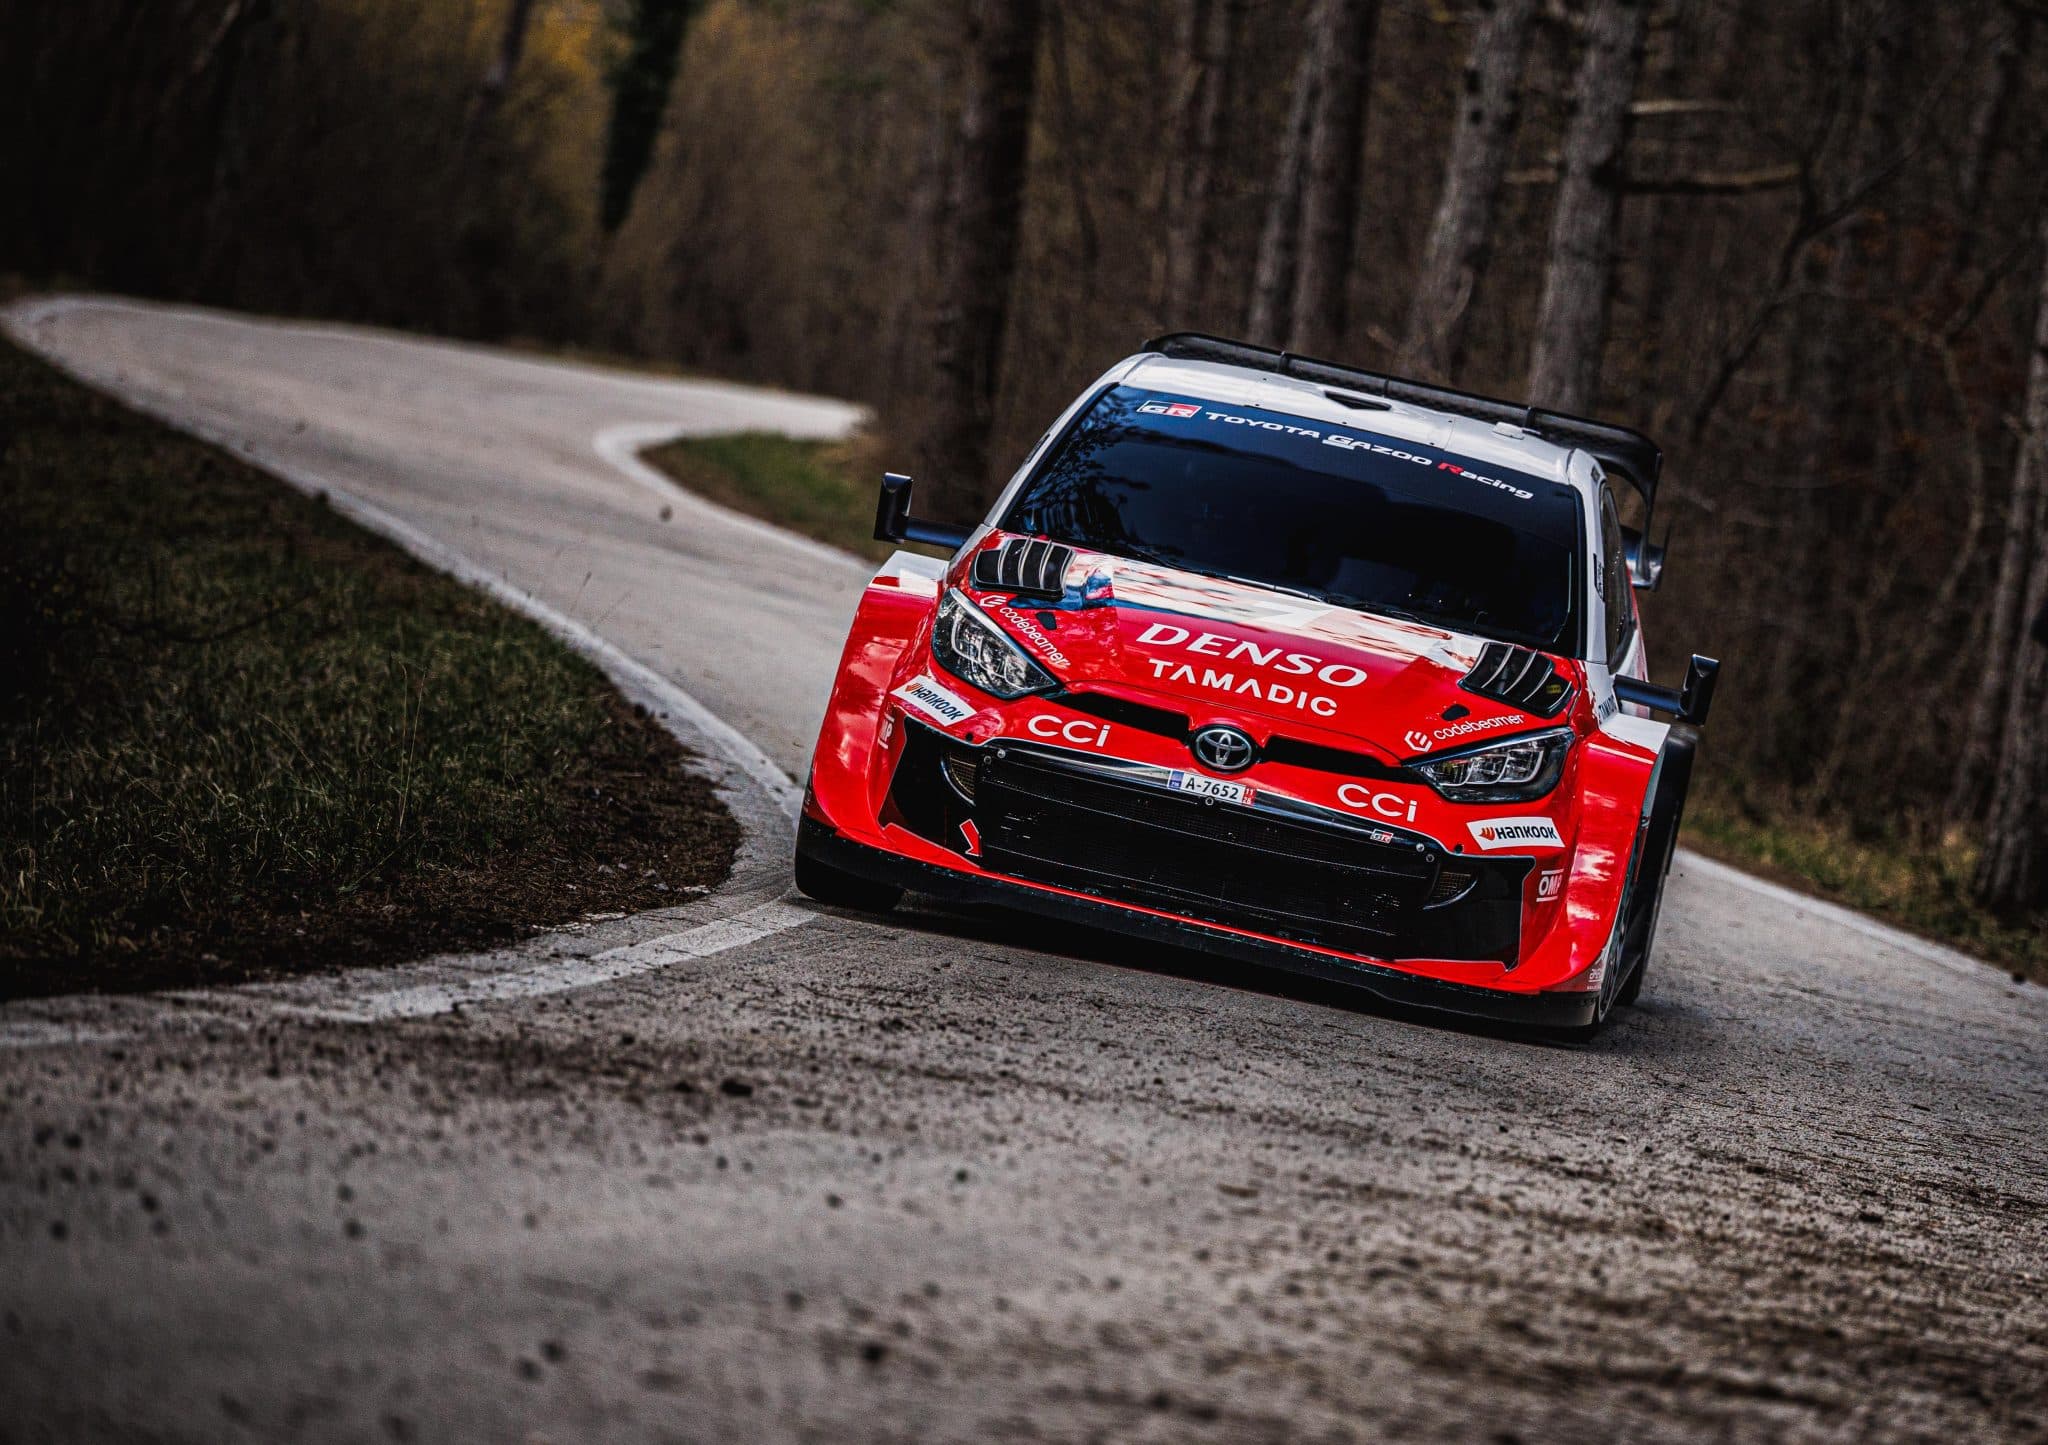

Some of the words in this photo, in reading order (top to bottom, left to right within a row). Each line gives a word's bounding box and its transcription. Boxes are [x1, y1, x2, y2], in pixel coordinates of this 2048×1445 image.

[1140, 403, 1195, 417] GR
[1206, 411, 1320, 439] TOYOTA
[1322, 434, 1432, 466] GAZOO
[1438, 462, 1534, 500] Racing
[999, 606, 1069, 668] codebeamer
[1136, 623, 1367, 687] DENSO
[1148, 658, 1338, 716] TAMADIC
[1027, 714, 1111, 747] CCi
[1433, 714, 1523, 741] codebeamer
[1185, 777, 1239, 799] A-7652
[1337, 784, 1417, 822] CCi
